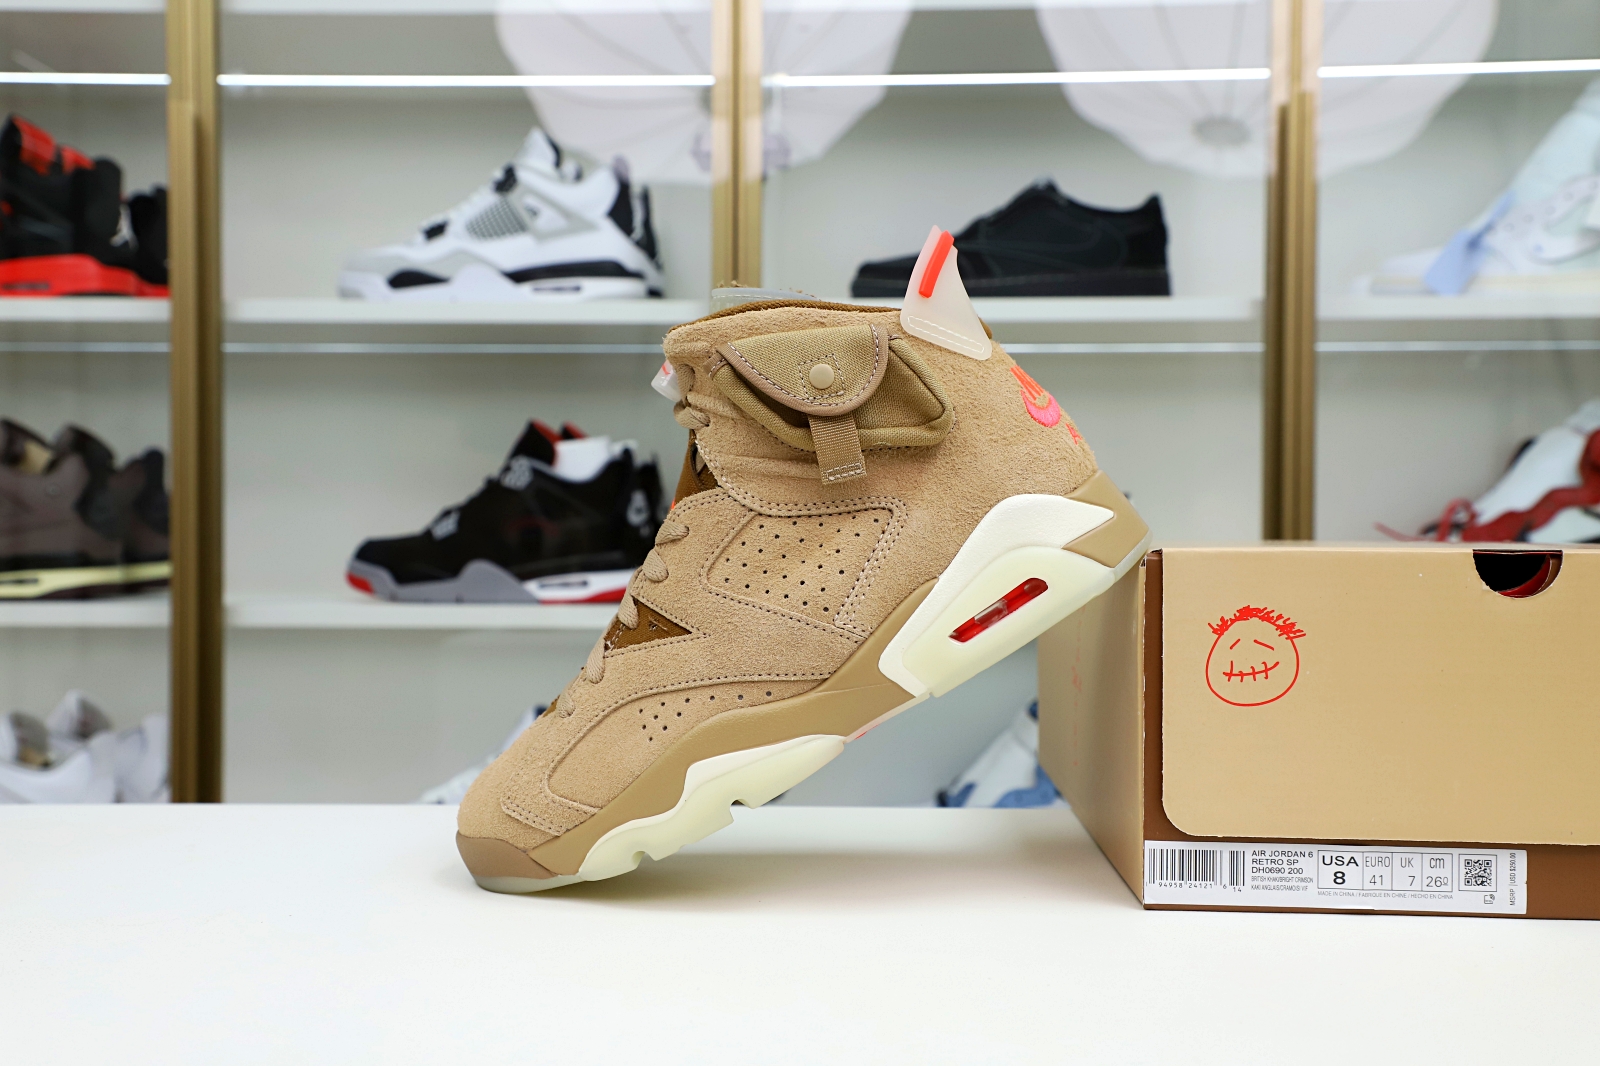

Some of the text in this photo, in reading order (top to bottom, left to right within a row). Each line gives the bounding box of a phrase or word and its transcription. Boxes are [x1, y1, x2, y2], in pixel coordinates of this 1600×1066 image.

[1269, 850, 1306, 858] JORDAN
[1251, 858, 1284, 866] RETRO
[1321, 855, 1359, 867] USA
[1365, 855, 1391, 868] EURO
[1400, 856, 1414, 868] UK
[1429, 857, 1445, 869] cm
[1251, 866, 1304, 875] DH0690 200
[1332, 871, 1346, 885] 8
[1369, 874, 1384, 886] 41
[1407, 875, 1416, 887] 7
[1158, 881, 1183, 889] 94958
